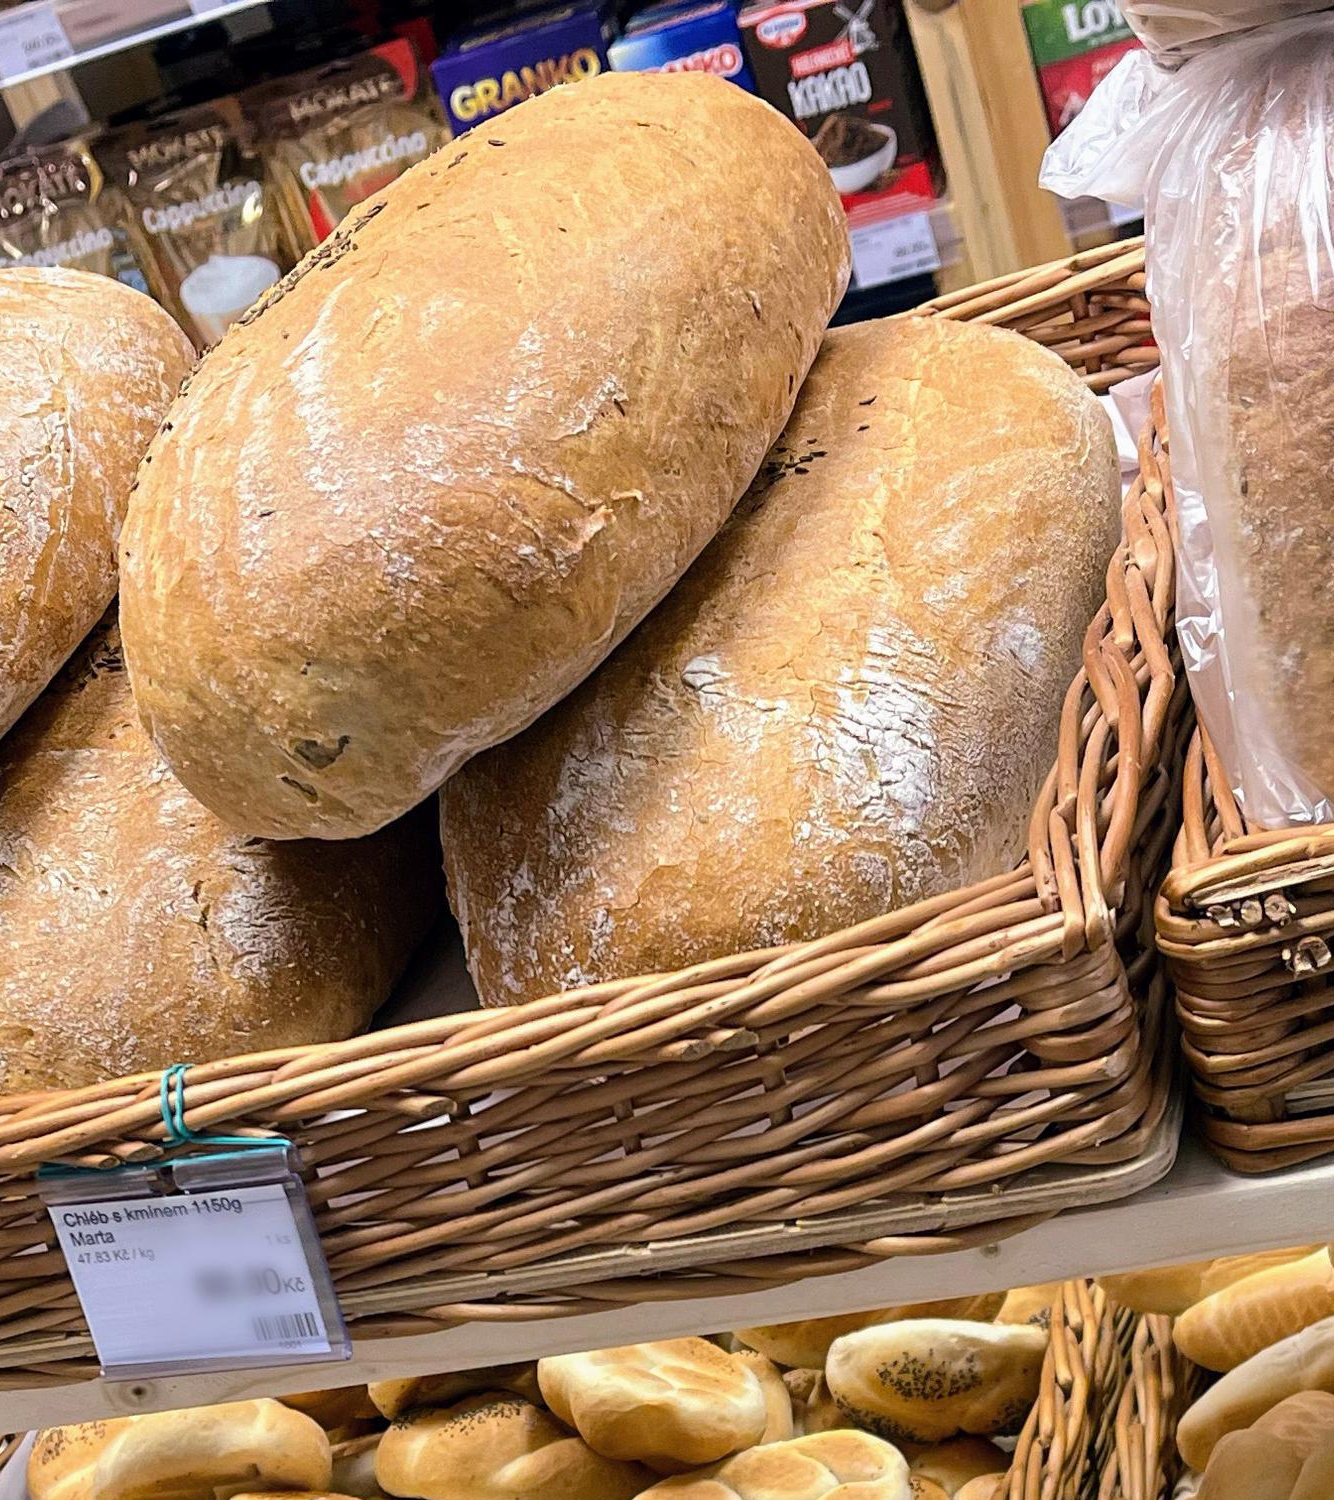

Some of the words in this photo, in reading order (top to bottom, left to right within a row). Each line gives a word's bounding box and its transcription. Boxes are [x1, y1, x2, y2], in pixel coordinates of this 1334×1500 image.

[450, 48, 601, 122] GRANKO
[788, 61, 872, 118] KAKAO
[300, 131, 428, 188] Cappuccino
[142, 181, 263, 233] Cappuccino
[63, 1210, 110, 1227] Chléb
[112, 1211, 122, 1223] s
[191, 1196, 243, 1214] 1150g
[69, 1230, 115, 1248] Marta
